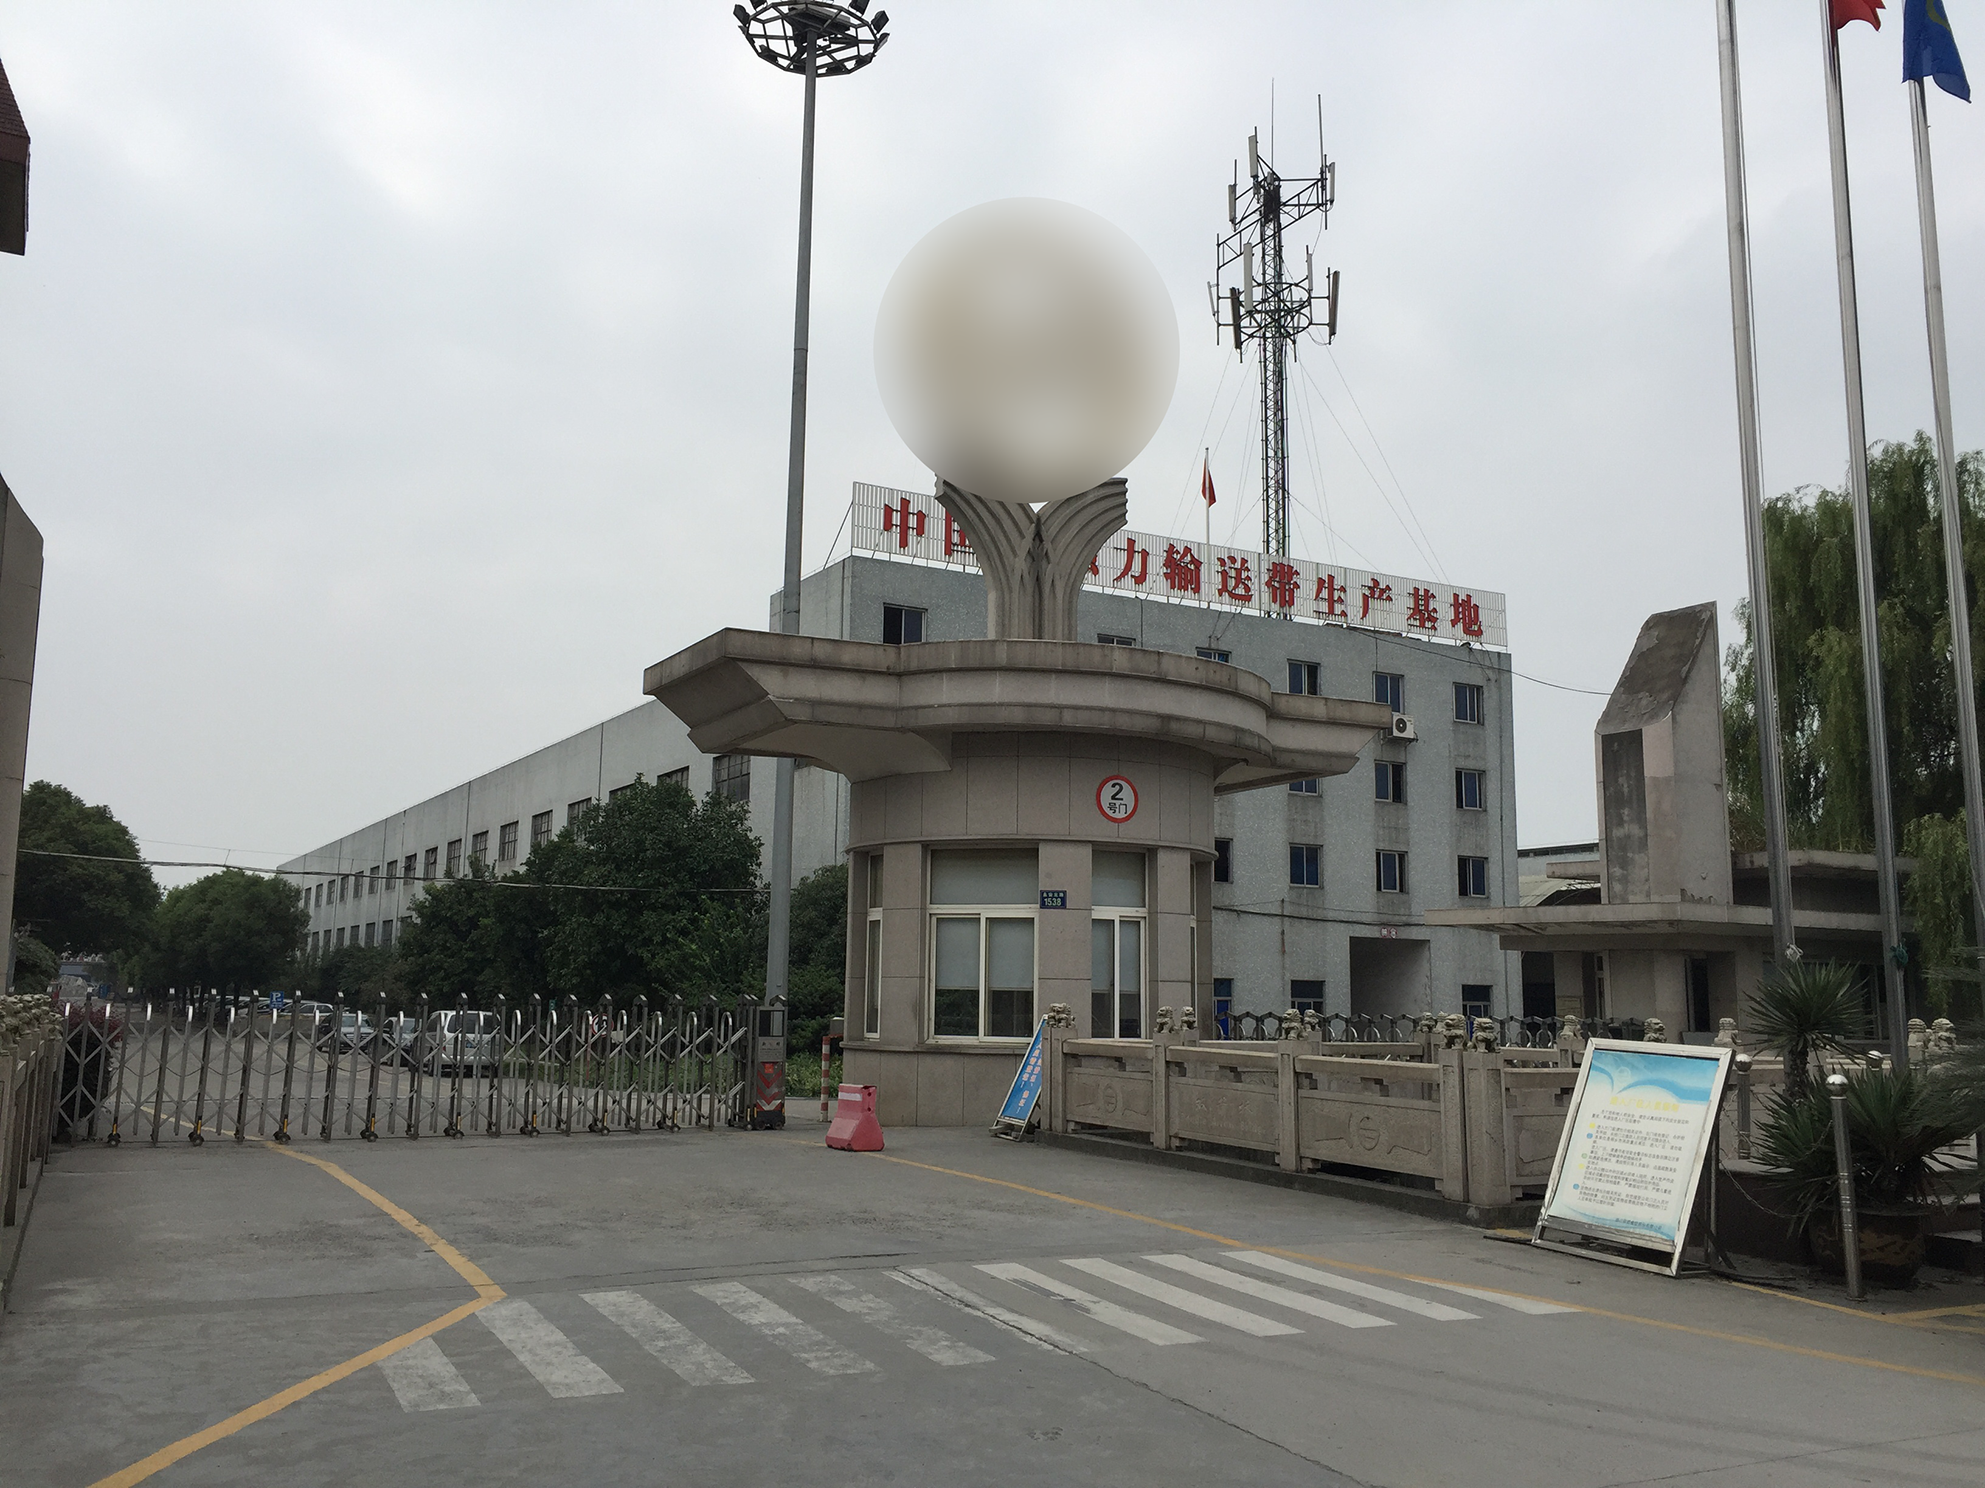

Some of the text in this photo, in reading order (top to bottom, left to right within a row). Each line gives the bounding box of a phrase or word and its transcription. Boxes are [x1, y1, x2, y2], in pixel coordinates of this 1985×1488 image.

[1110, 782, 1124, 801] 2
[1107, 802, 1128, 814] 号门
[1043, 898, 1062, 906] 1538
[272, 992, 282, 1002] P
